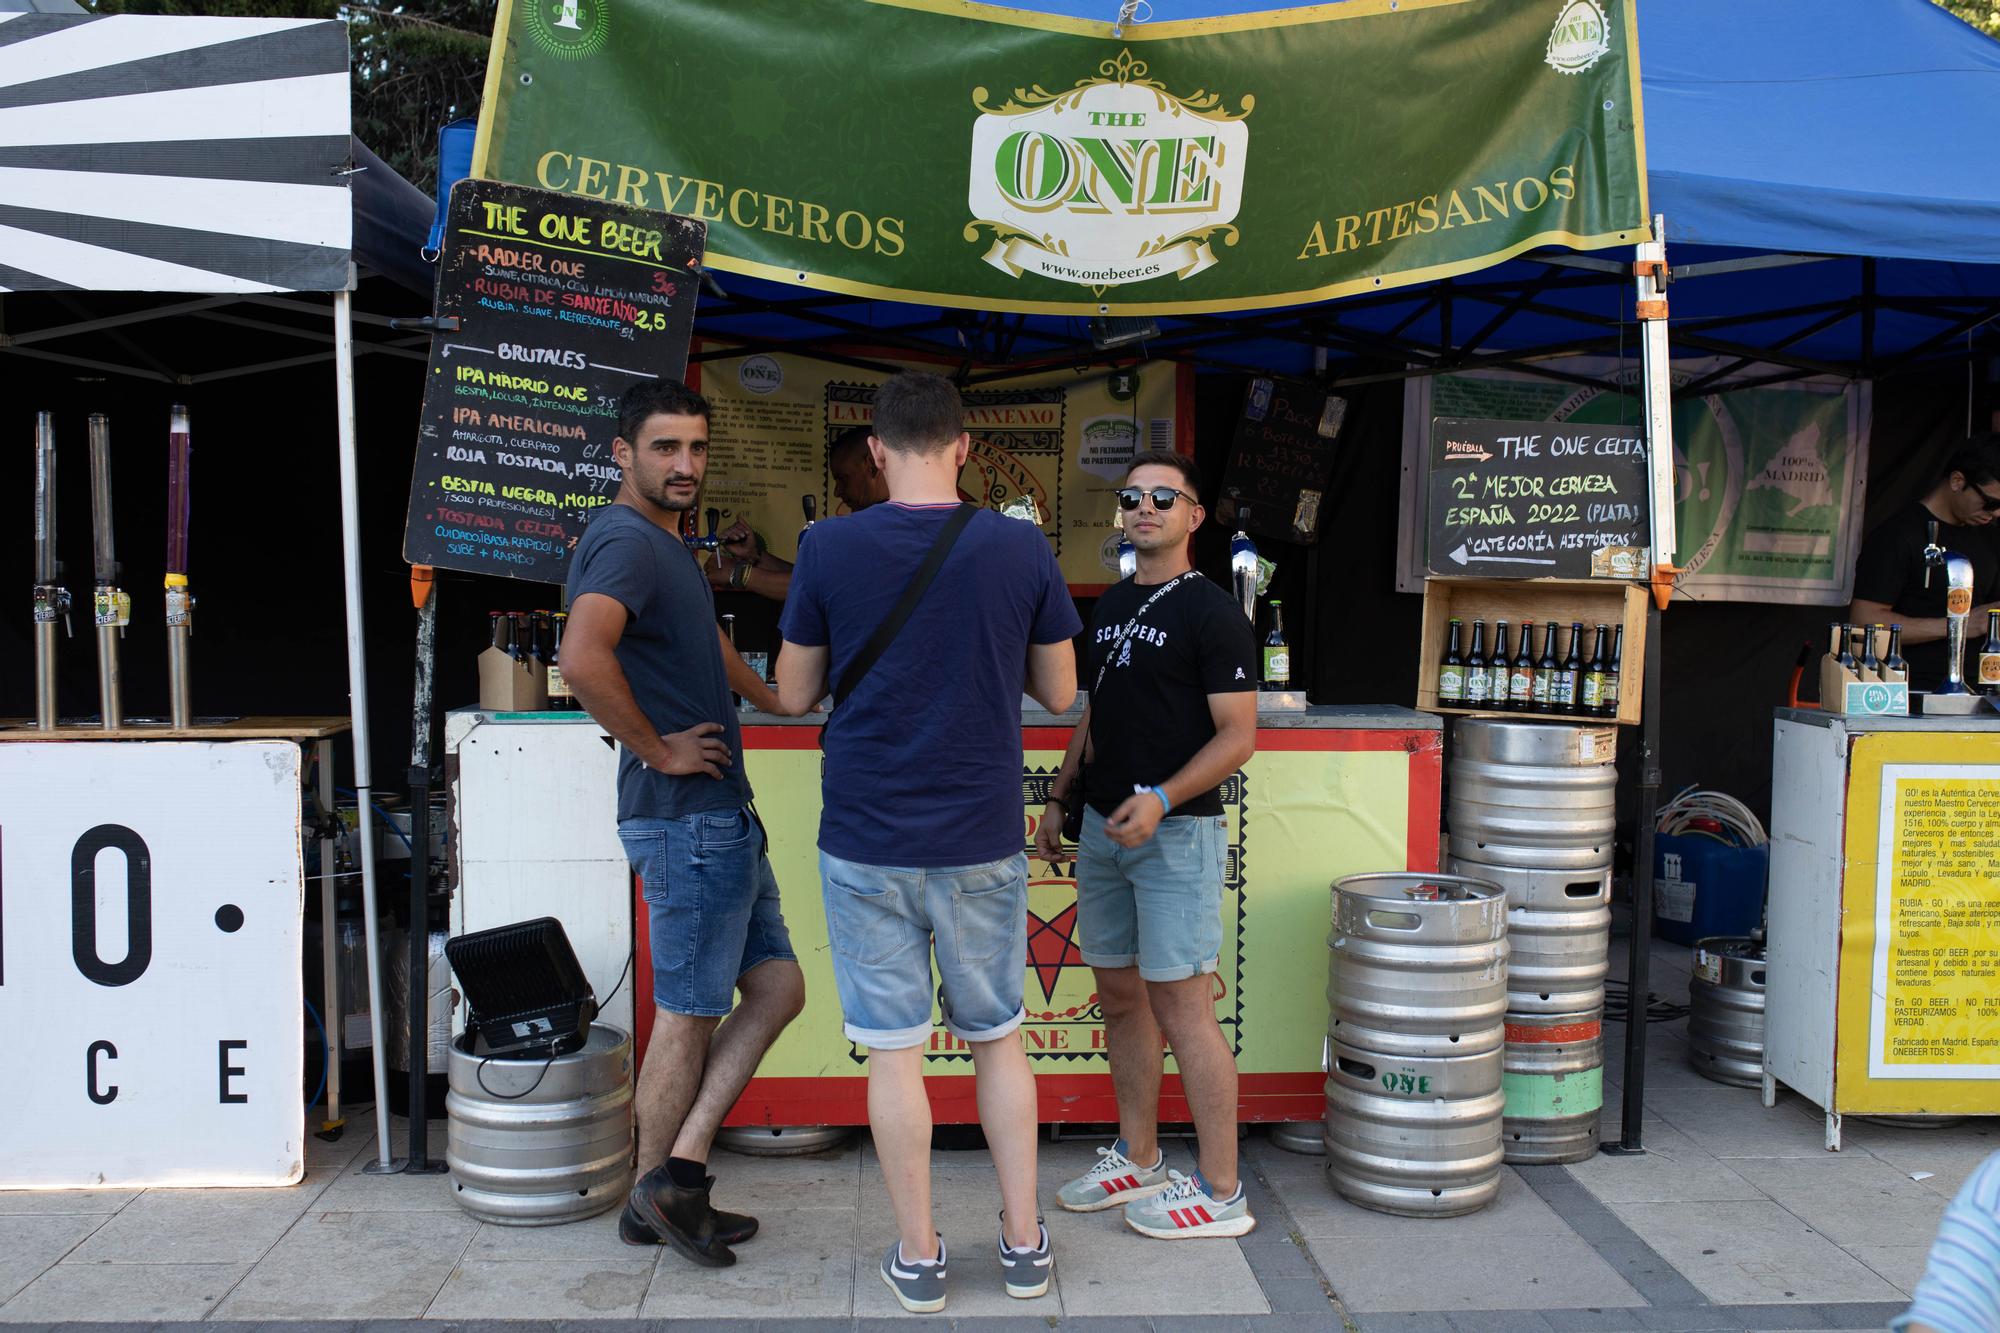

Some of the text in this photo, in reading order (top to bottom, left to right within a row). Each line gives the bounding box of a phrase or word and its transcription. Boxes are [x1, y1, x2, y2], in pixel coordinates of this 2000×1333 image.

[552, 5, 586, 20] ONE
[1554, 21, 1599, 47] ONE
[1552, 49, 1599, 62] www.onebeer.es
[1087, 111, 1147, 126] THE
[994, 130, 1226, 215] ONE
[536, 149, 906, 258] CERVECEROS
[1297, 163, 1576, 260] ARTESANOS
[482, 201, 663, 261] THE ONE BEER
[550, 259, 586, 279] ONE
[1041, 261, 1160, 280] www.onebeer.es
[475, 278, 666, 331] RUBIA DE SANXENXO 2,5
[498, 342, 586, 370] BRUTALES
[744, 368, 777, 381] ONE
[456, 366, 486, 385] IPA
[489, 372, 549, 394] MADRID
[553, 385, 588, 401] ONE
[834, 405, 1053, 423] LA ANXENXO
[453, 408, 587, 440] IPA AMERICANA
[511, 438, 560, 453] CUERPAZO
[1497, 435, 1542, 460] THE
[1551, 436, 1590, 455] ONE
[1595, 437, 1647, 459] CELTA
[447, 446, 486, 465] ROJA
[1764, 470, 1825, 482] MADRID
[442, 476, 495, 496] BESTIA
[1482, 475, 1545, 500] MEJOR
[1550, 474, 1618, 495] CERVEZA
[1445, 503, 1639, 526] ESPAÑA 2022 (PLATA)
[437, 508, 566, 539] TOSTADA CELTA
[447, 543, 475, 556] SUBE
[1149, 578, 1180, 603] adidas
[1096, 624, 1167, 647] SCAPERS
[1932, 789, 1939, 797] la
[1935, 799, 1964, 807] Maestro
[1904, 809, 1945, 818] experiencia
[1979, 809, 1985, 817] la
[1989, 809, 2000, 818] Ley
[1928, 819, 1949, 827] 100%
[1903, 829, 1944, 837] Cerveceros
[1948, 829, 1956, 837] de
[1903, 840, 1932, 848] mejores
[1902, 849, 1993, 857] naturales sostenibles
[1902, 860, 1922, 868] mejor
[1901, 879, 1930, 887] MADRID
[1900, 899, 1922, 907] RUBIA
[1900, 919, 1980, 928] refrescante Baja sola
[1896, 969, 1927, 977] contiene
[1962, 969, 1995, 977] naturales
[1896, 979, 1931, 987] levaduras
[1895, 1008, 1956, 1016] PASTEURIZAMOS
[1894, 1018, 1924, 1026] VERDAD
[1020, 1030, 1068, 1049] NE
[1893, 1038, 1928, 1046] Fabricado
[1893, 1048, 1944, 1056] ONEBEER TDS
[1382, 1072, 1433, 1095] ONE
